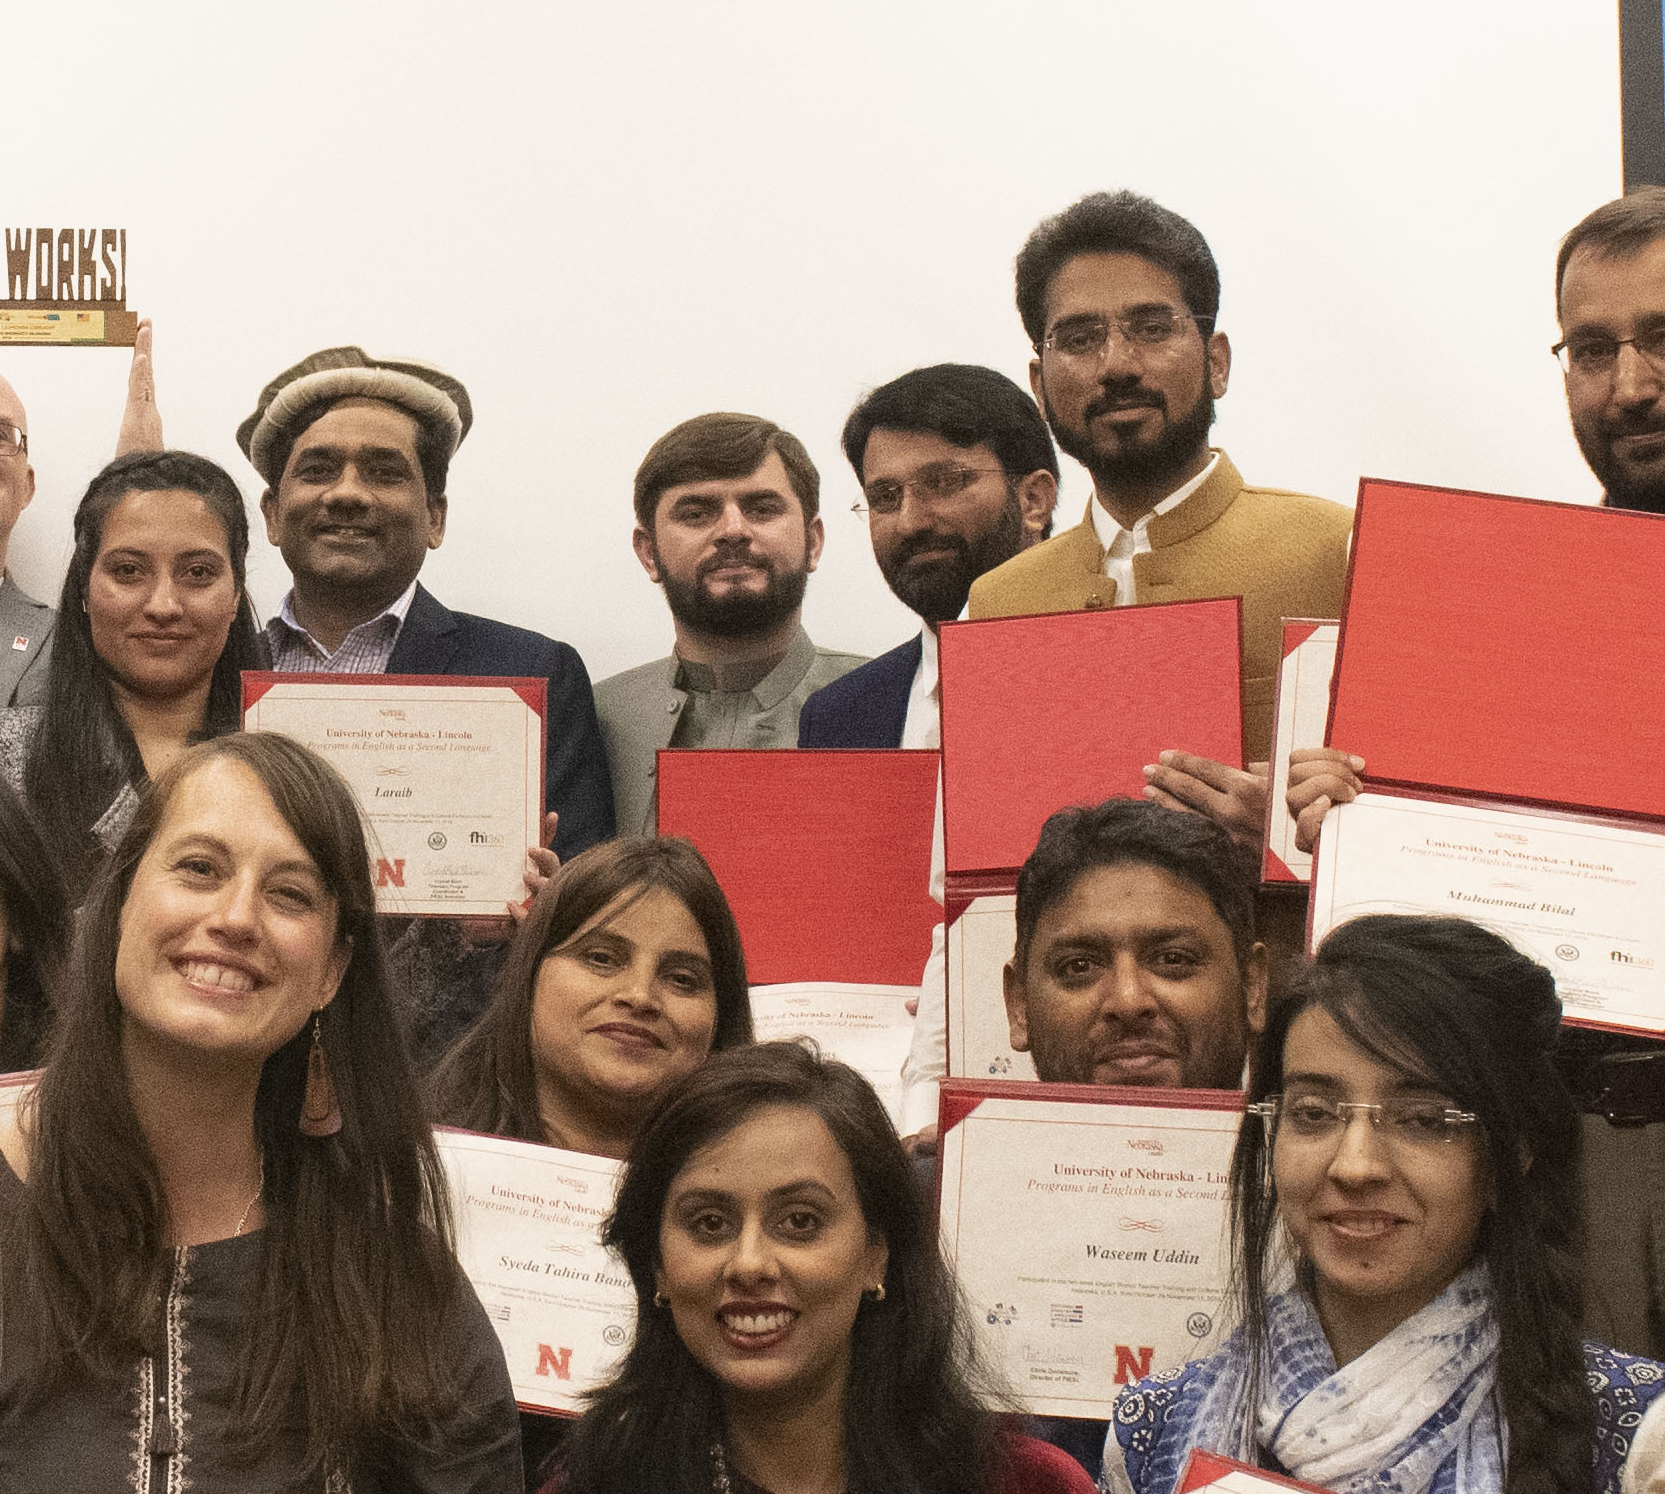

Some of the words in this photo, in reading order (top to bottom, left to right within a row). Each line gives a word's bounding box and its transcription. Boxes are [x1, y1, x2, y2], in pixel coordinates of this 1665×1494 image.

[6, 228, 126, 300] WORKS!
[326, 729, 372, 739] University
[375, 730, 384, 738] of
[386, 730, 429, 739] Nebraska
[438, 731, 472, 739] Lincoln
[375, 787, 413, 798] Laraib
[1425, 838, 1485, 852] University
[1488, 847, 1502, 857] of
[1502, 848, 1559, 865] Nebraska
[1569, 860, 1614, 873] Lincoln
[377, 859, 405, 887] N
[1446, 890, 1536, 912] Muhammad
[1540, 904, 1577, 917] Bilal
[1053, 1164, 1115, 1179] University
[1120, 1168, 1132, 1179] of
[1136, 1169, 1194, 1182] Nebraska
[491, 1185, 546, 1206] University
[550, 1199, 561, 1209] of
[1086, 1244, 1147, 1263] Waseem
[1153, 1248, 1200, 1265] Uddin
[499, 1256, 540, 1274] Syeda
[544, 1263, 590, 1282] Tahira
[536, 1343, 574, 1380] N
[1113, 1344, 1154, 1385] N
